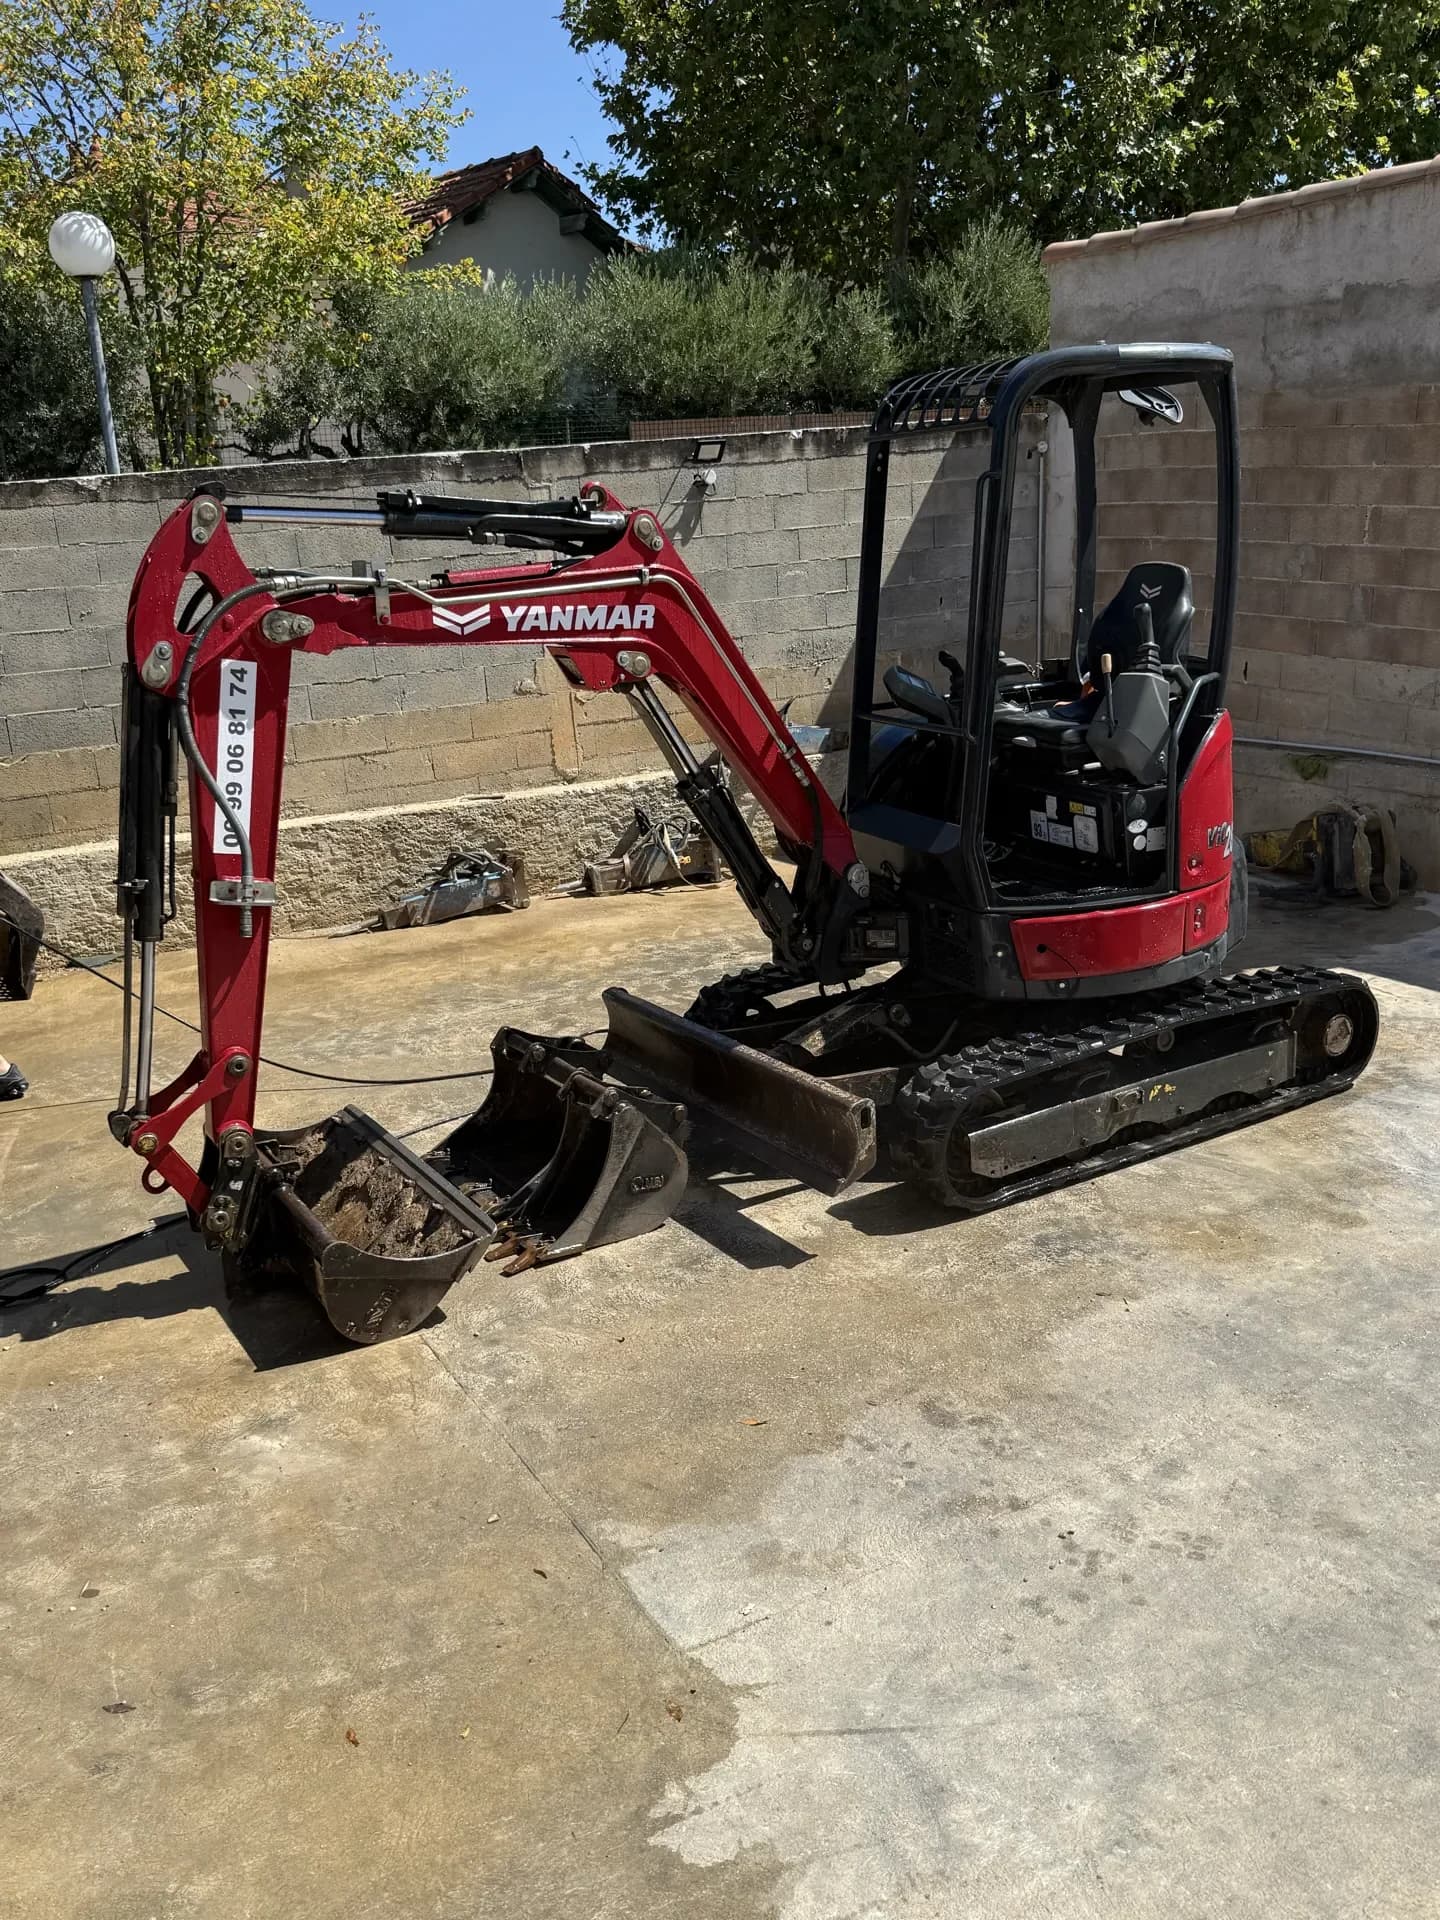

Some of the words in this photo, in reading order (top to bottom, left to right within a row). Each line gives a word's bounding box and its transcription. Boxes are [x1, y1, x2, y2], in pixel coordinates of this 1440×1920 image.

[500, 604, 655, 632] YANMAR
[229, 667, 248, 697] 74
[228, 708, 246, 736] 81
[226, 744, 244, 774] 06
[225, 781, 243, 811] 99
